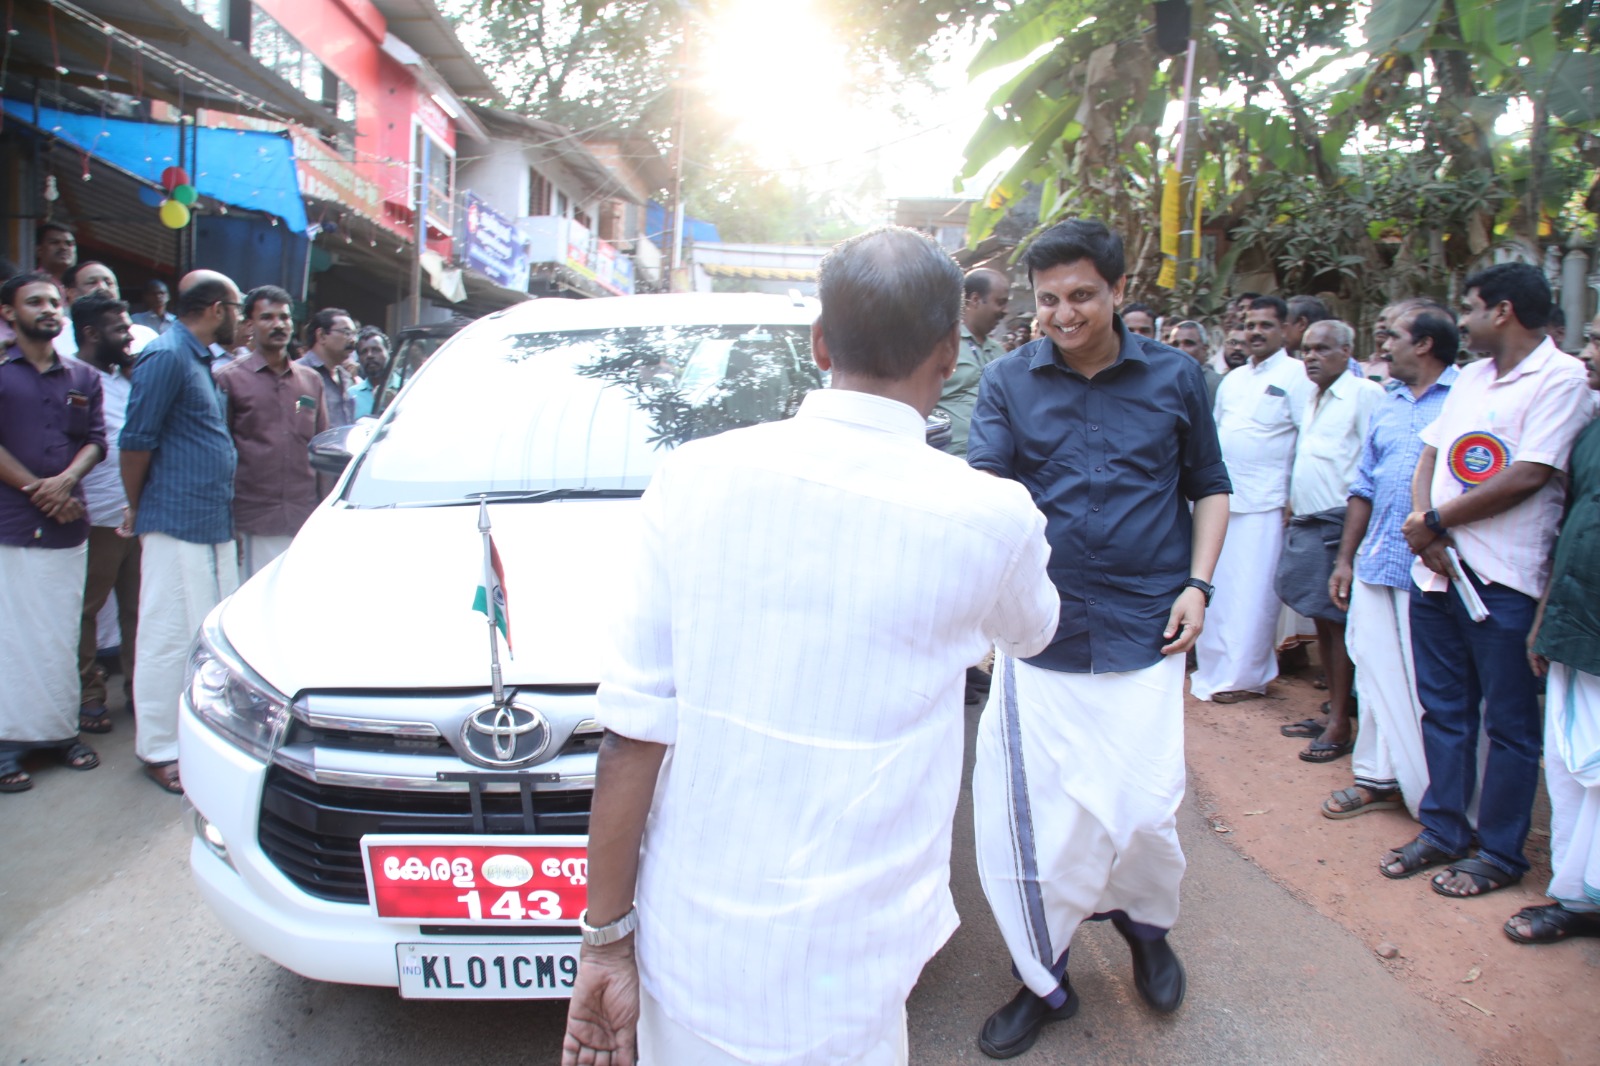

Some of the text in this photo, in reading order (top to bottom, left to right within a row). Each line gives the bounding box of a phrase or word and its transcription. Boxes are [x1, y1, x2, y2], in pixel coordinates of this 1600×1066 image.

[383, 856, 476, 888] കേരള
[457, 889, 563, 920] 143
[402, 965, 422, 976] IND
